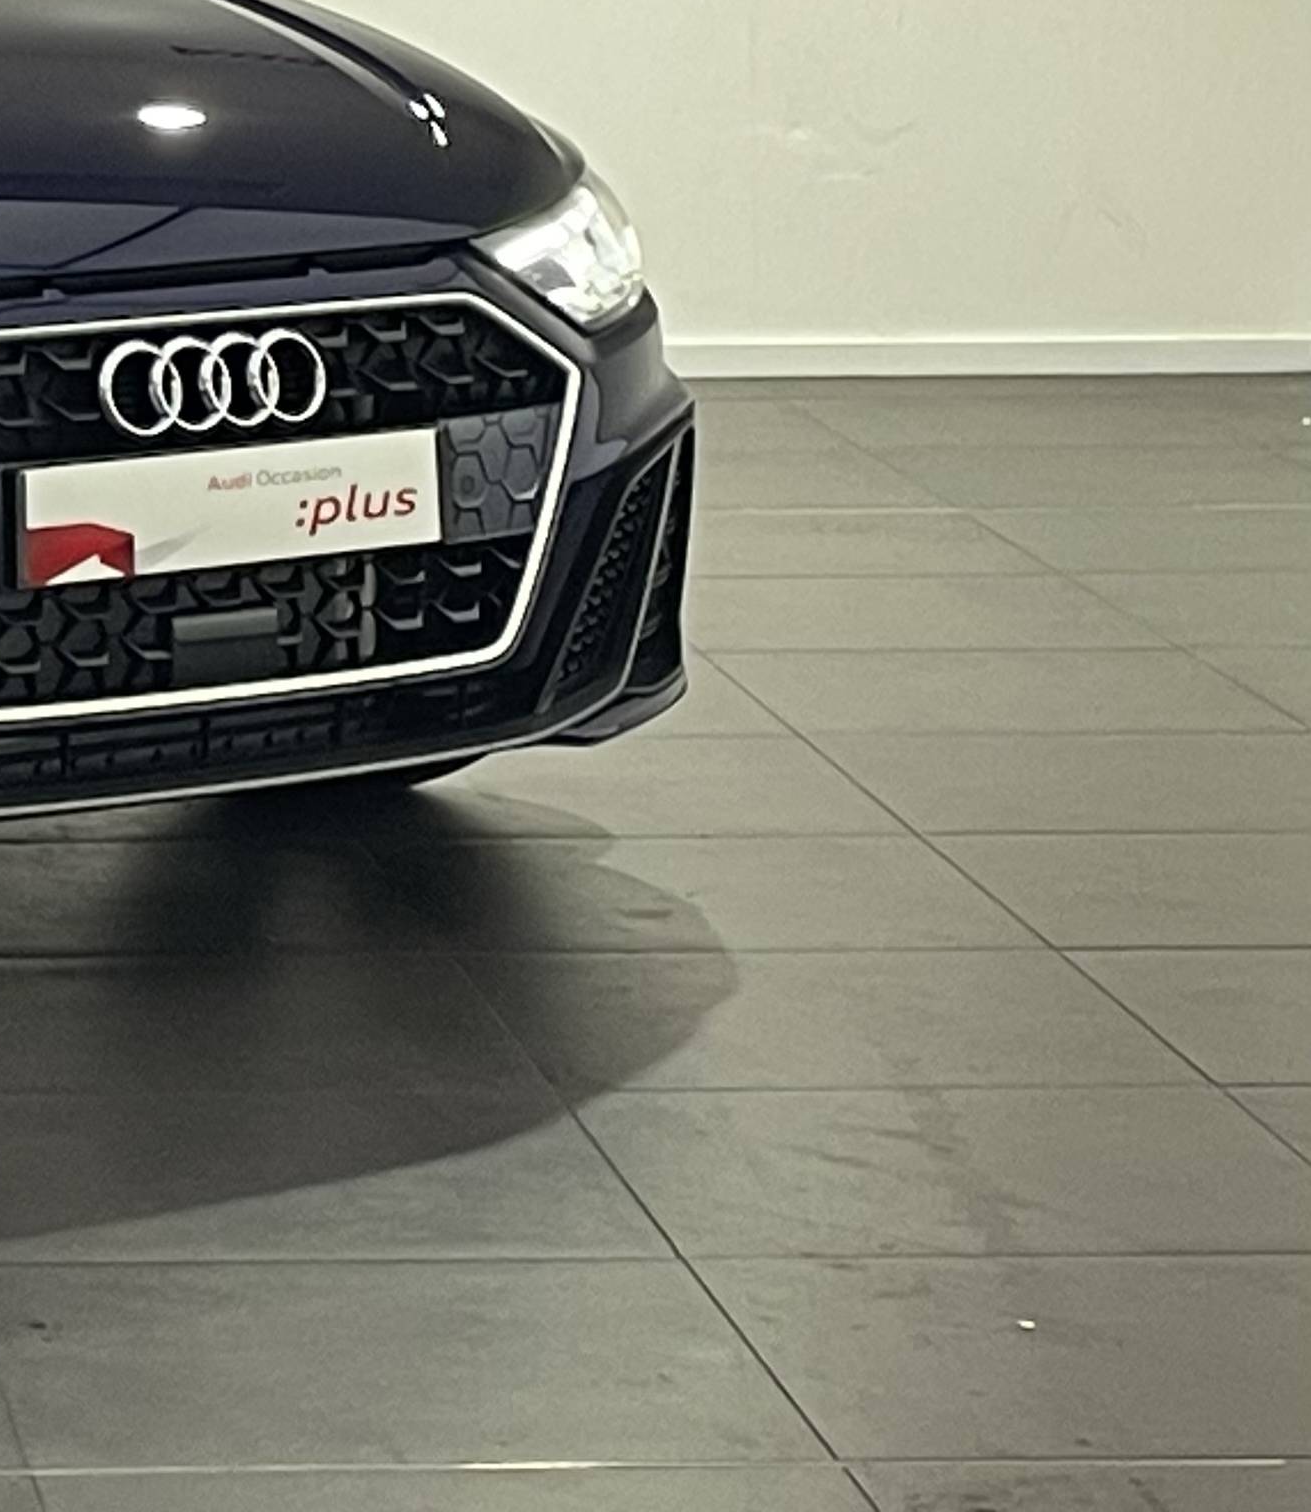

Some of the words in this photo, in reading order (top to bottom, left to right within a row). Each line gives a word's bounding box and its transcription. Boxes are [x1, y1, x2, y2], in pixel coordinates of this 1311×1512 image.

[207, 473, 253, 490] Audi
[256, 466, 342, 486] Occasion
[295, 484, 417, 536] :plus
